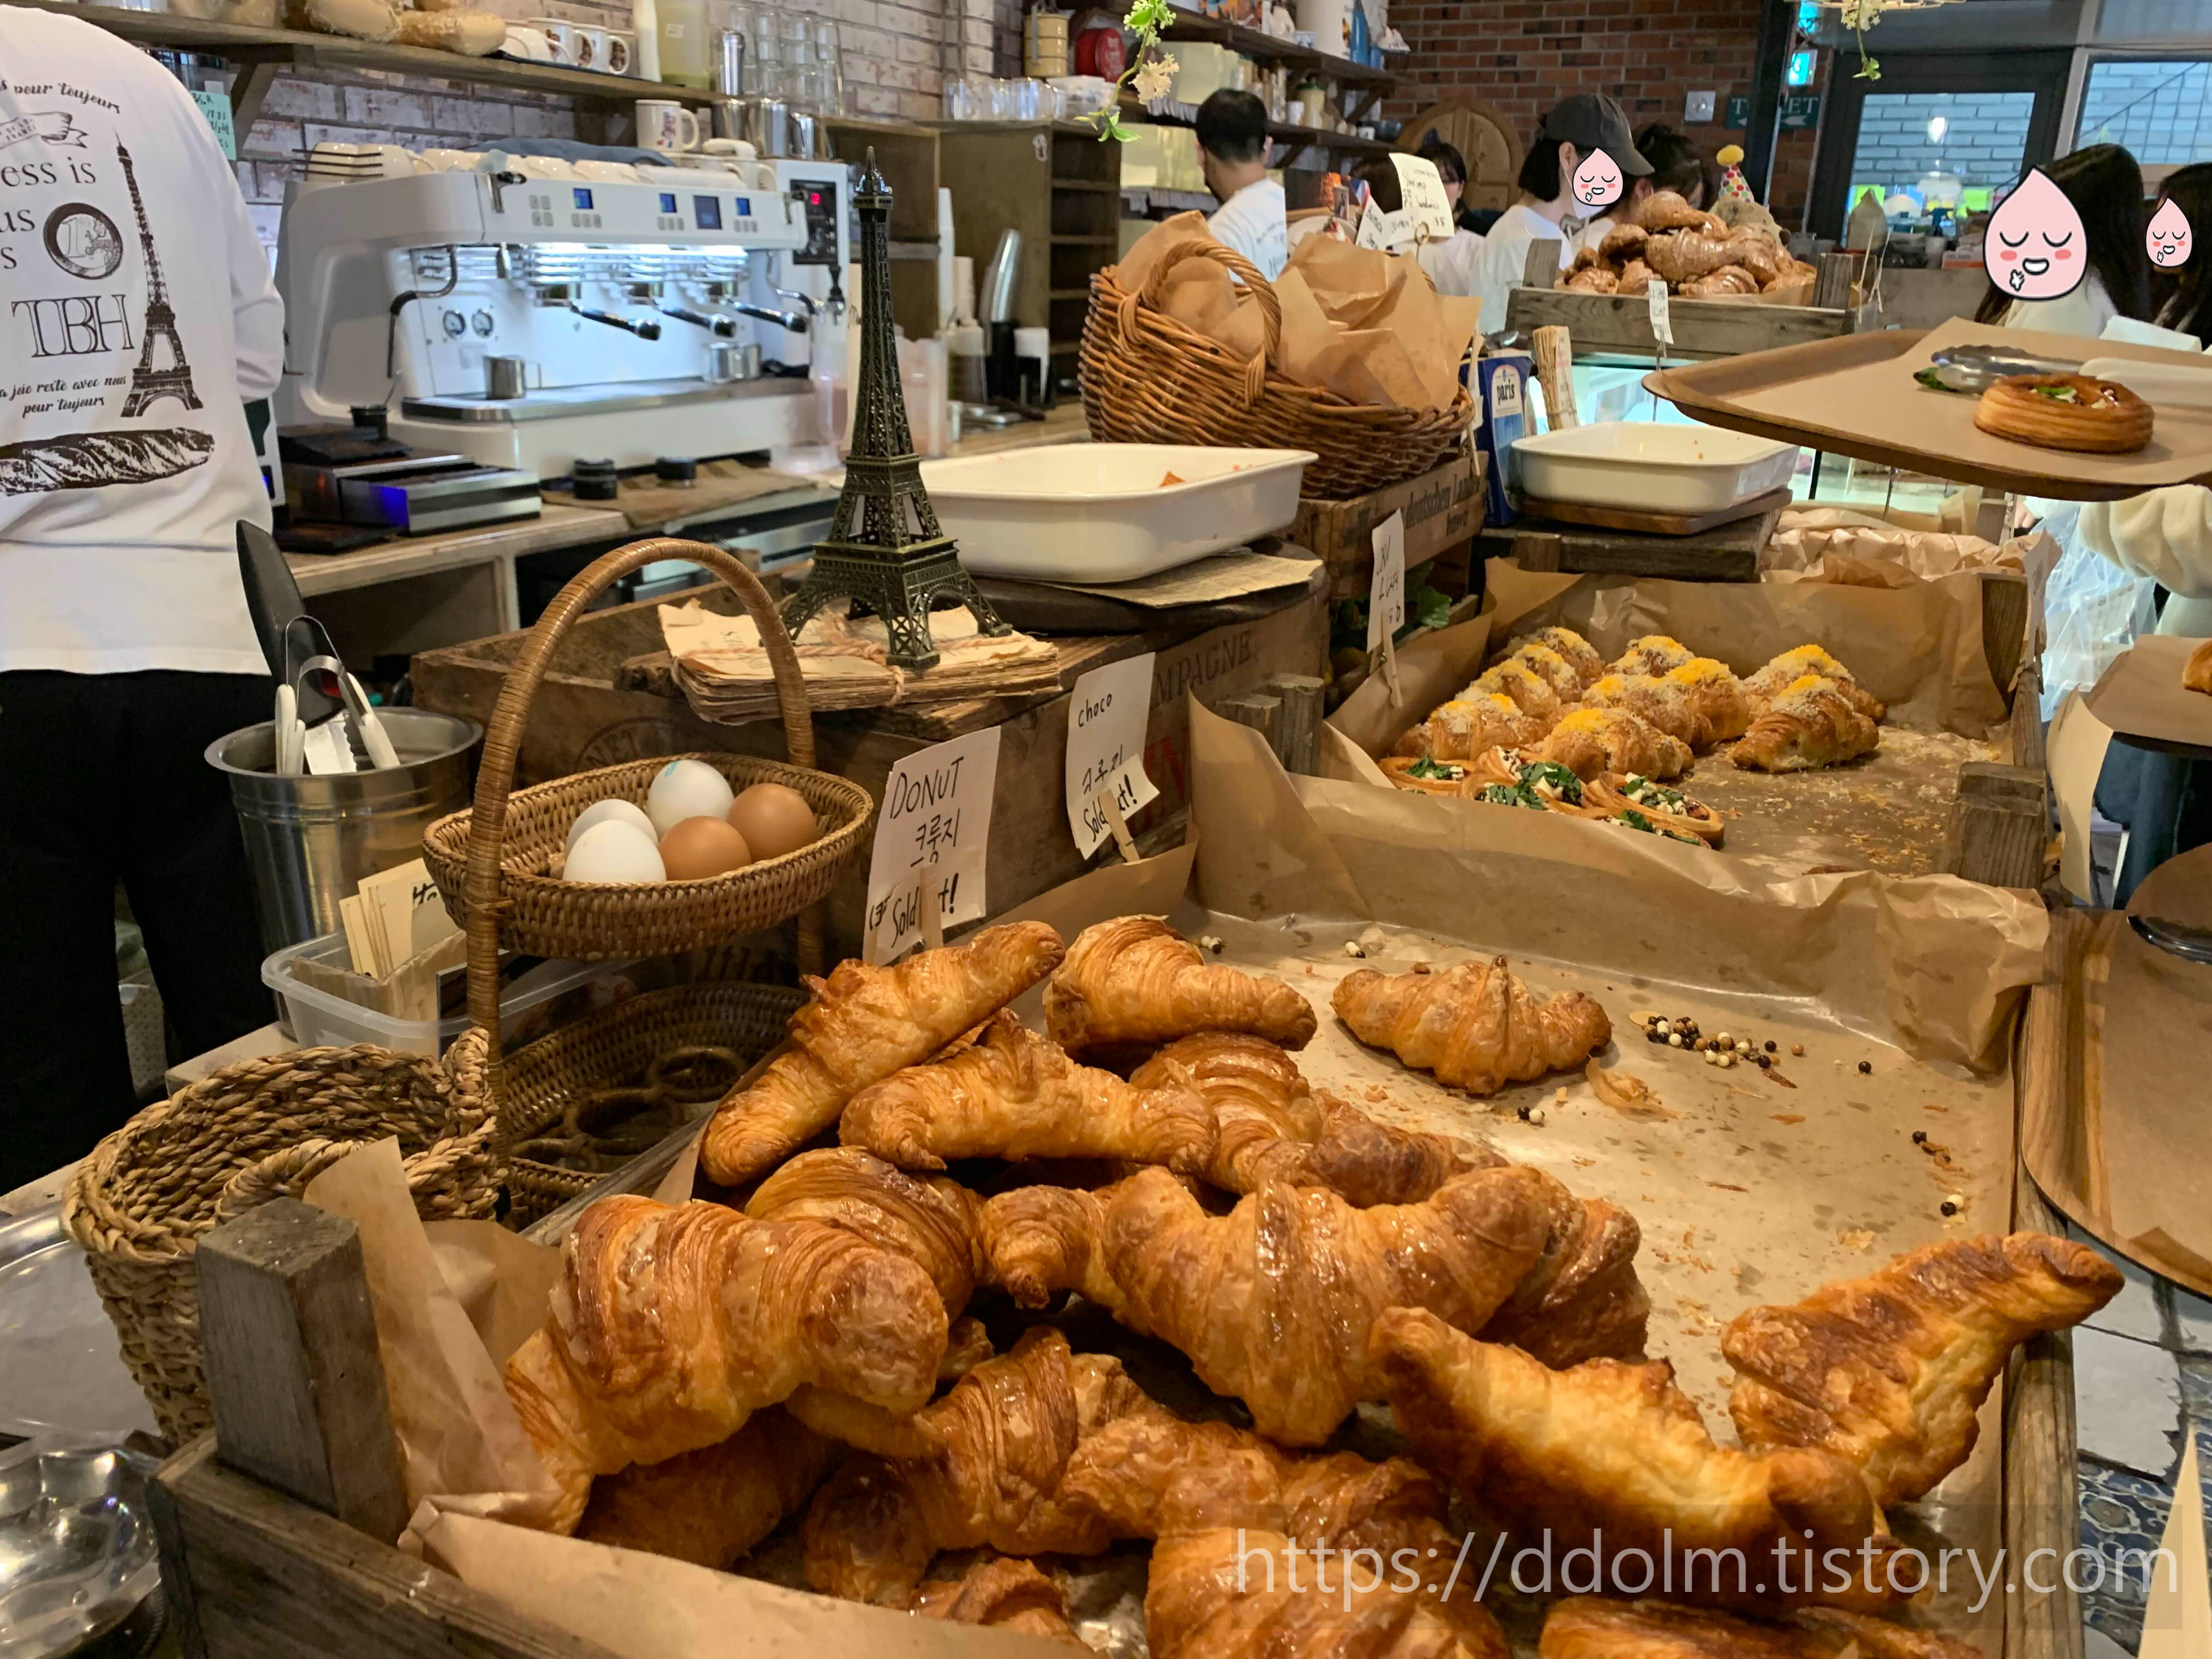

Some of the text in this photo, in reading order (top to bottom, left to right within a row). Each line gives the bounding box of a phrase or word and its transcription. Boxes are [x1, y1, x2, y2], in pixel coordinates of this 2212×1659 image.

[13, 84, 53, 95] pour
[67, 156, 97, 184] is
[9, 383, 32, 401] joie
[36, 378, 68, 393] reste
[72, 378, 100, 391] avec
[104, 375, 127, 386] nous
[1496, 379, 1515, 406] paris
[22, 396, 105, 419] pour toujours
[1077, 693, 1112, 728] choco
[889, 756, 964, 819] DONUT
[1082, 795, 1108, 843] Sold
[891, 886, 920, 949] Sold
